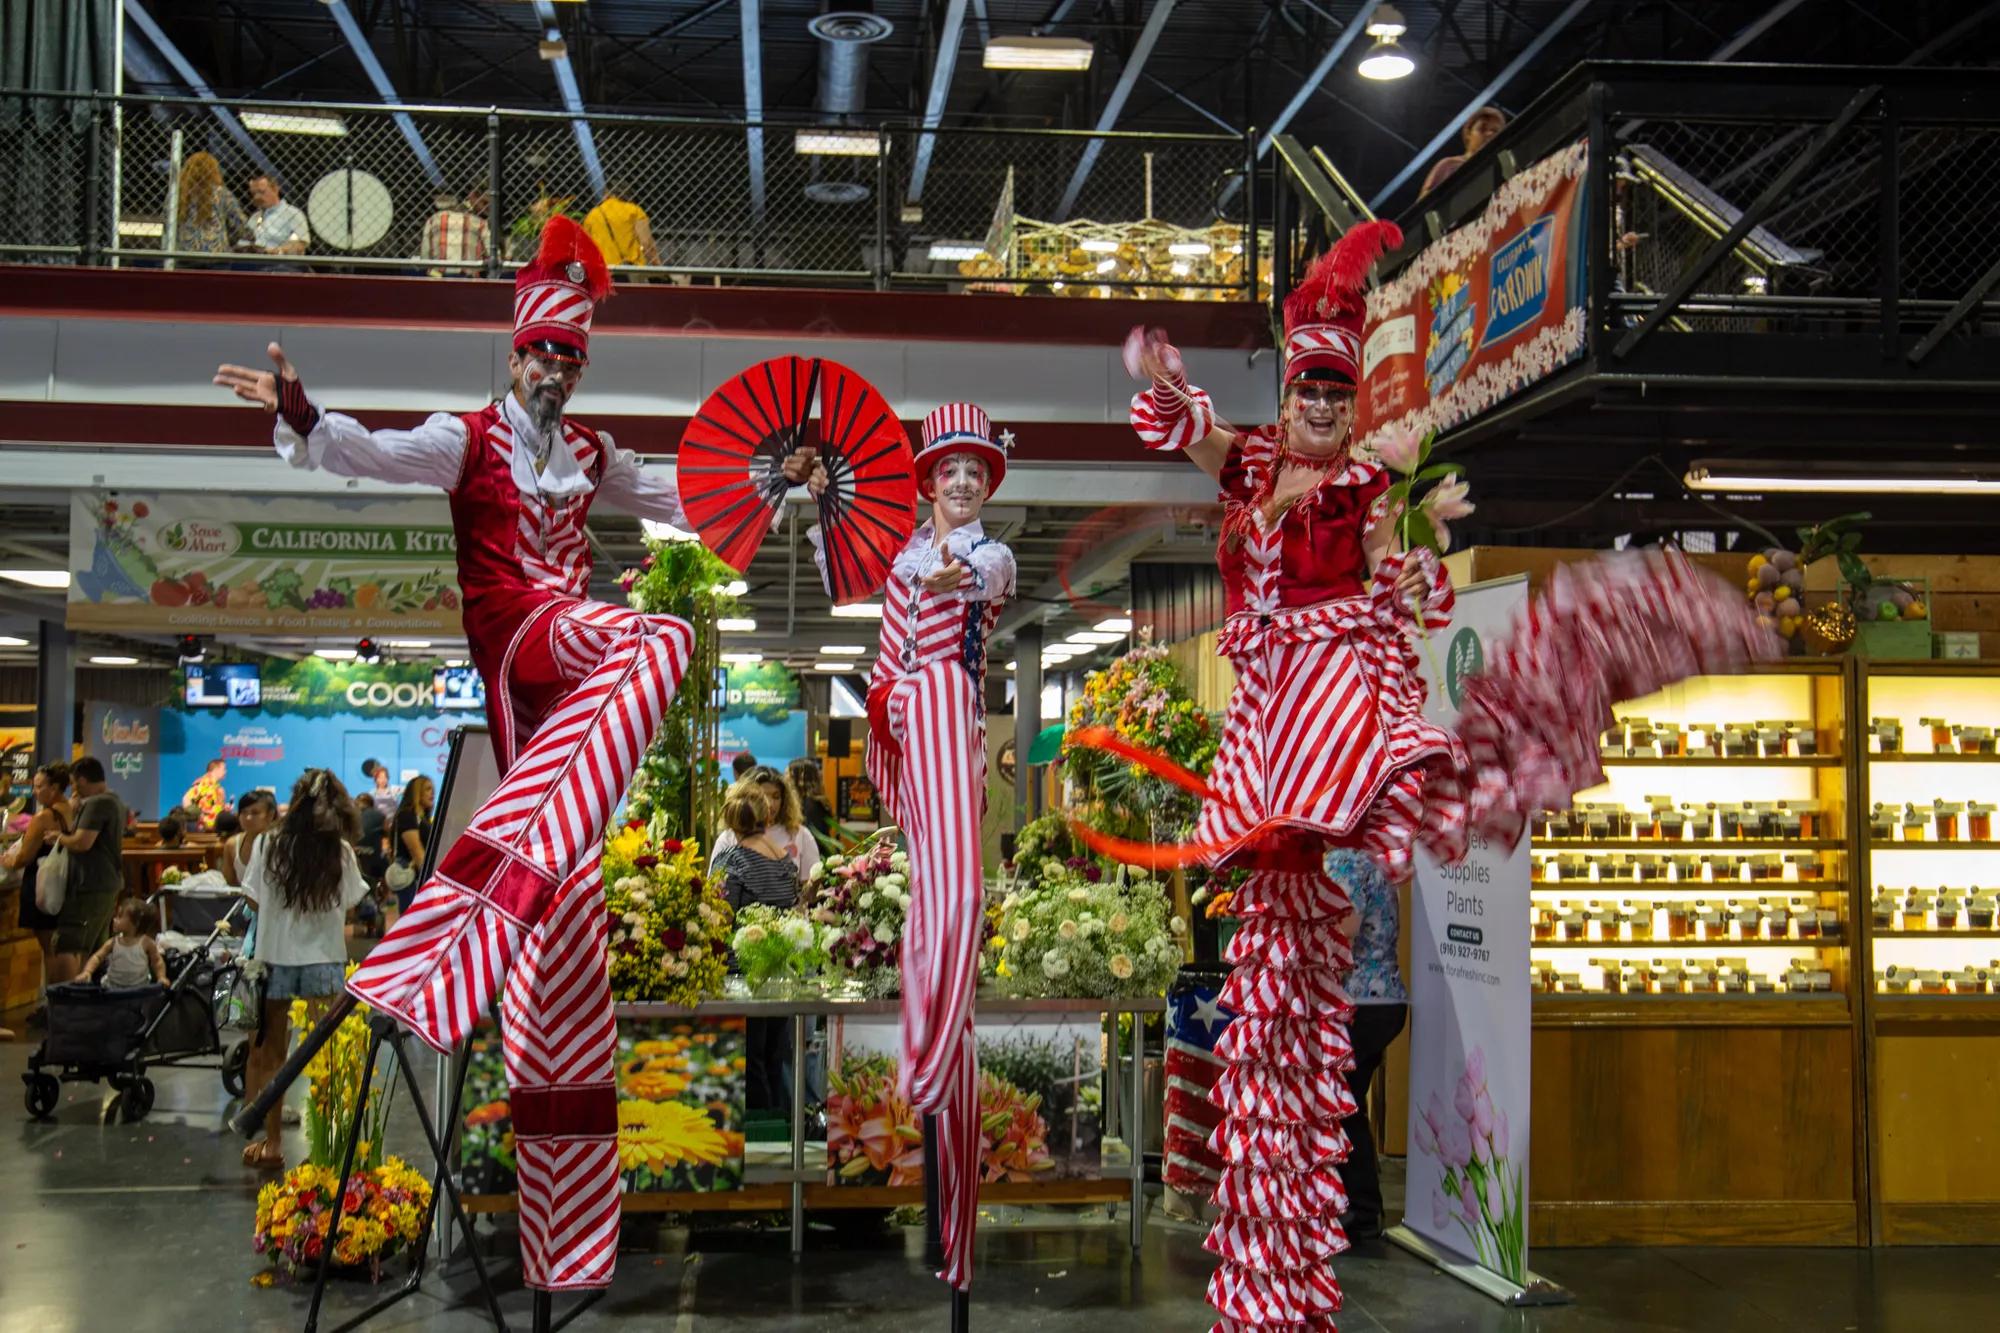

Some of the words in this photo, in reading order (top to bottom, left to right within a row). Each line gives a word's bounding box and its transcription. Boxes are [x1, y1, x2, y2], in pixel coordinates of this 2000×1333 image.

[188, 523, 222, 537] Save
[251, 527, 397, 552] CALIFORNIA
[188, 537, 226, 552] Mart
[168, 614, 216, 628] Cooking
[220, 614, 260, 626] Demos
[278, 616, 306, 627] Food
[310, 617, 348, 629] Tasting
[367, 617, 441, 631] Competitions
[346, 681, 434, 708] COOK
[1440, 861, 1490, 885] Supplies
[1447, 890, 1484, 916] Plants
[1450, 927, 1472, 939] CONTACT
[1440, 942, 1457, 958] (916)
[1457, 945, 1490, 962] 927-9767
